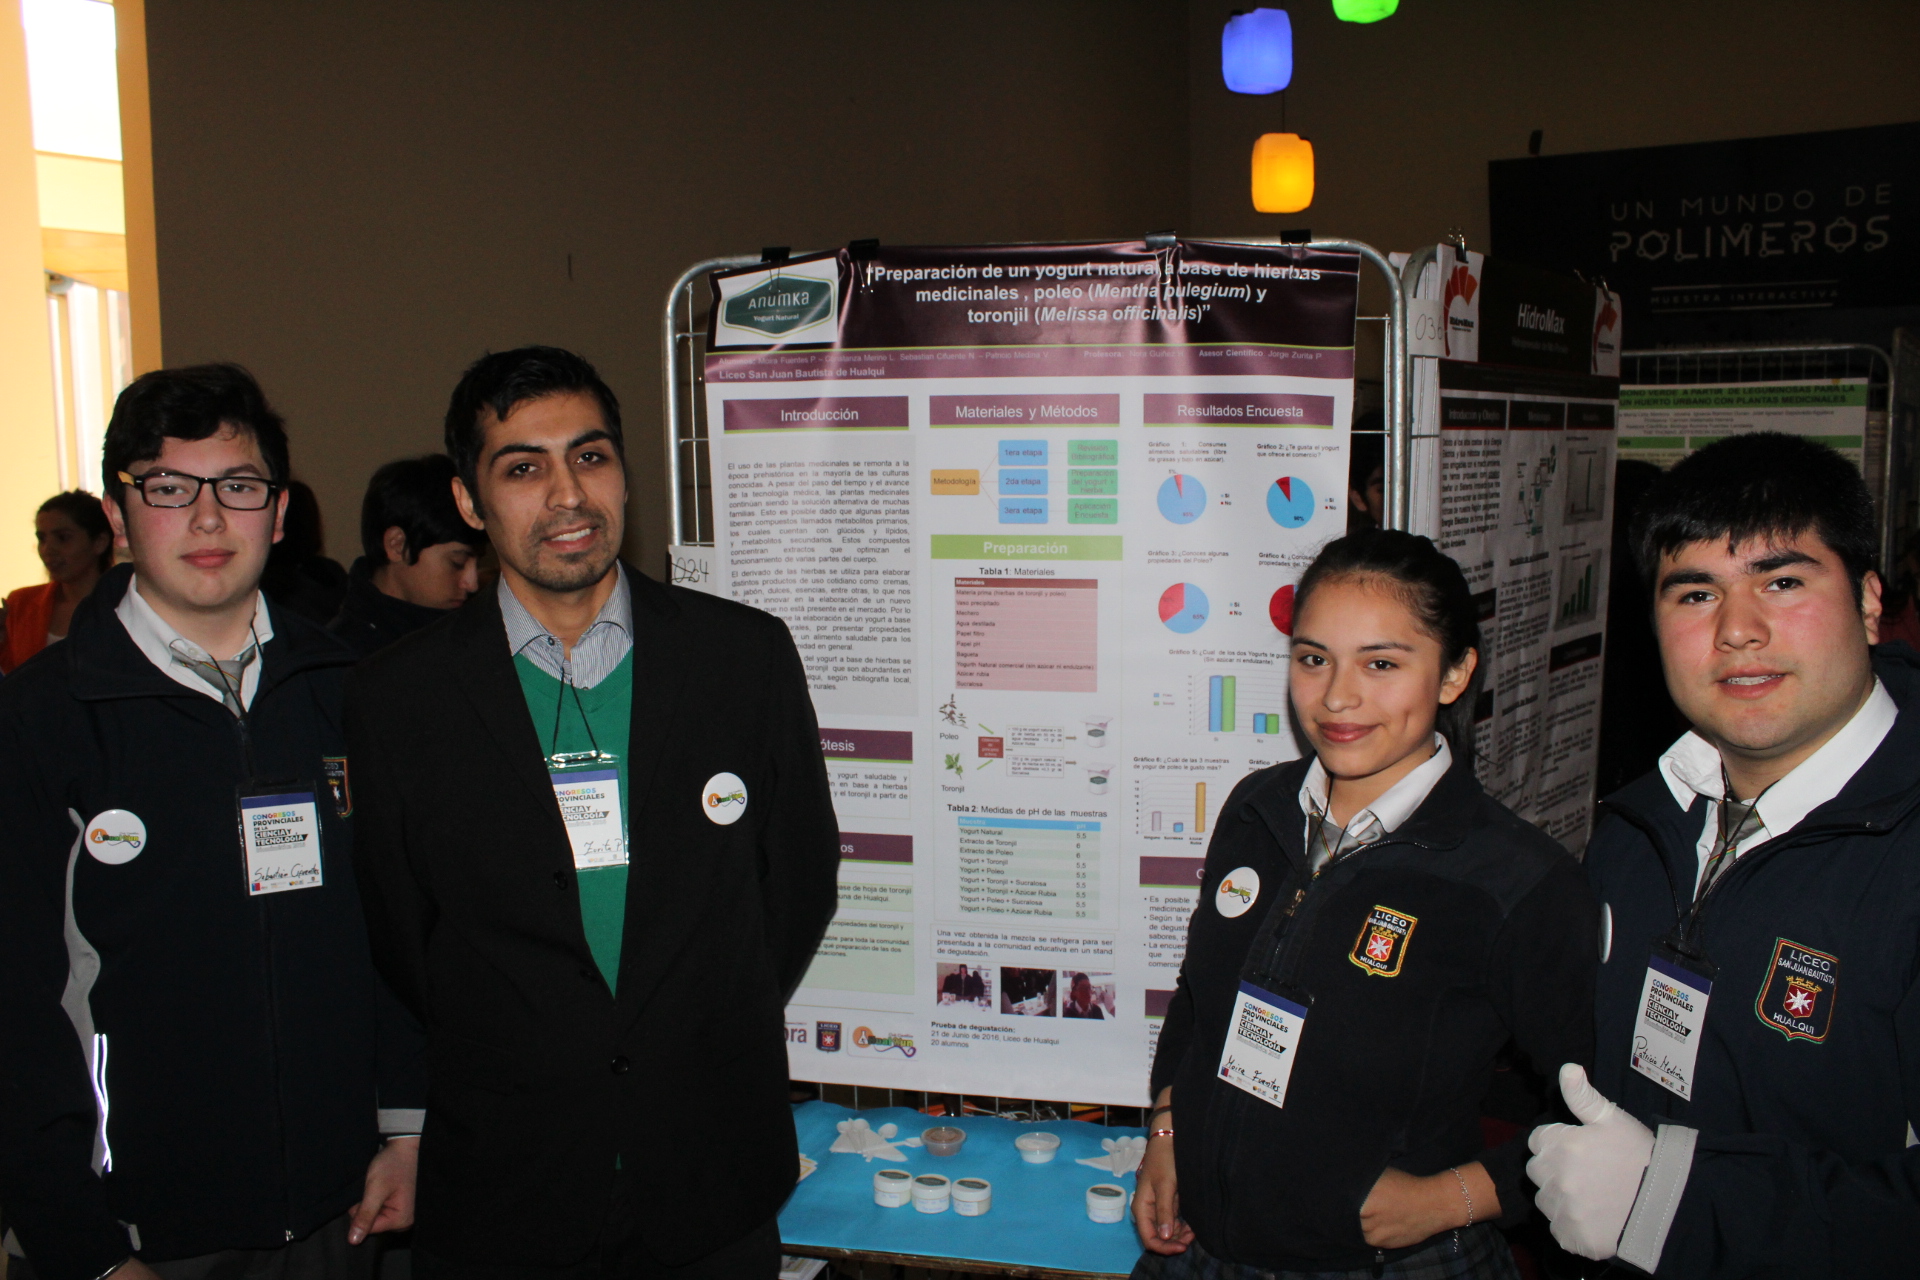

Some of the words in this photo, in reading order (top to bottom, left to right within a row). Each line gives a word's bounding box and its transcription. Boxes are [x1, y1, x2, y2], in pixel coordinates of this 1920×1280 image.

[1611, 201, 1653, 221] UN
[1681, 190, 1814, 217] MUNDO
[1845, 183, 1892, 206] DE
[1610, 215, 1890, 262] POLIMEROS
[982, 264, 1003, 279] de
[1008, 267, 1030, 279] un
[1035, 263, 1095, 280] yogurt
[1098, 262, 1159, 277] natural
[1165, 264, 1174, 276] a
[1179, 261, 1221, 276] base
[1227, 263, 1248, 278] de
[1254, 263, 1321, 281] hierbas
[916, 284, 1019, 302] medicinales
[1034, 284, 1083, 301] poleo
[1088, 283, 1158, 300] (Mentha
[1163, 283, 1251, 301] pulegium)
[1257, 288, 1267, 303] y
[1651, 294, 1721, 304] MUESTRA
[1730, 290, 1839, 301] INTERACTIVA
[753, 315, 774, 323] Yogurt
[775, 313, 800, 321] Natural
[968, 308, 1028, 327] toronjil
[1034, 306, 1107, 324] (Melissa
[1518, 303, 1565, 334] HidroMax
[1199, 350, 1223, 358] Asesor
[1226, 350, 1263, 358] Científico
[719, 370, 745, 379] Liceo
[748, 370, 767, 379] San
[769, 370, 793, 379] Juan
[795, 369, 832, 378] Bautista
[836, 368, 847, 377] de
[850, 367, 885, 378] Hualqui
[1620, 389, 1646, 397] BONO
[1648, 389, 1678, 397] VERDE
[1690, 388, 1723, 396] PARTIR
[1728, 387, 1741, 395] DE
[1743, 386, 1812, 395] LEGUMINOSAS
[1814, 385, 1838, 393] PARA
[1841, 384, 1855, 392] LA
[1620, 398, 1633, 406] UN
[1634, 398, 1671, 406] HUERTO
[1673, 397, 1711, 405] URBANO
[1714, 396, 1733, 405] CON
[1736, 396, 1779, 404] PLANTAS
[1781, 395, 1846, 404] MEDICINALES
[781, 408, 859, 422] Introducción
[956, 406, 1023, 418] Materiales
[1029, 408, 1036, 420] y
[1040, 405, 1098, 417] Métodos
[1178, 405, 1243, 417] Resultados
[1246, 405, 1304, 417] Encuesta
[1005, 449, 1020, 457] 1era
[1022, 450, 1043, 458] etapa
[728, 462, 735, 470] El
[779, 461, 805, 470] plantas
[809, 460, 849, 468] medicinales
[934, 478, 976, 486] Metodología
[1022, 507, 1043, 515] etapa
[983, 541, 1068, 556] Preparación
[979, 567, 1002, 576] Tabla
[1014, 568, 1055, 577] Materiales
[555, 788, 596, 797] ONGRESOS
[941, 785, 965, 793] Toronjil
[557, 793, 605, 803] OVINCIALES
[252, 811, 296, 820] CONGRESOS
[947, 804, 970, 813] Tabla
[971, 805, 979, 813] 2:
[981, 806, 1013, 815] Medidas
[1015, 807, 1026, 815] de
[1028, 808, 1039, 817] pH
[1042, 808, 1052, 816] de
[1054, 808, 1066, 816] las
[1070, 810, 1108, 818] muestras
[253, 816, 304, 827] PROVINCIALES
[255, 829, 286, 839] CIENCIA
[256, 833, 304, 846] TECNOLOGÍA
[1375, 911, 1407, 927] LICEO
[1359, 955, 1388, 970] HUALQUI
[1790, 950, 1830, 971] LICEO
[1653, 979, 1690, 1001] CONGRESOS
[1651, 986, 1694, 1012] PROVINCIALES
[1244, 1002, 1284, 1024] CONGRESOS
[1648, 1000, 1674, 1018] CIENCIA
[1674, 1012, 1679, 1020] Y
[931, 1021, 956, 1029] Prueba
[969, 1024, 1015, 1033] degustación:
[1242, 1008, 1289, 1033] PROVINCIALES
[1646, 1010, 1687, 1035] TECNOLOGÍA
[1773, 1012, 1815, 1035] HUALQUI
[1240, 1020, 1268, 1037] CIENCIA
[952, 1031, 970, 1039] Junio
[1033, 1036, 1060, 1046] Hualqui
[1238, 1027, 1281, 1052] TECNOLOGÍA
[1660, 1055, 1685, 1082] Medina
[1252, 1069, 1280, 1093] Fuentes
